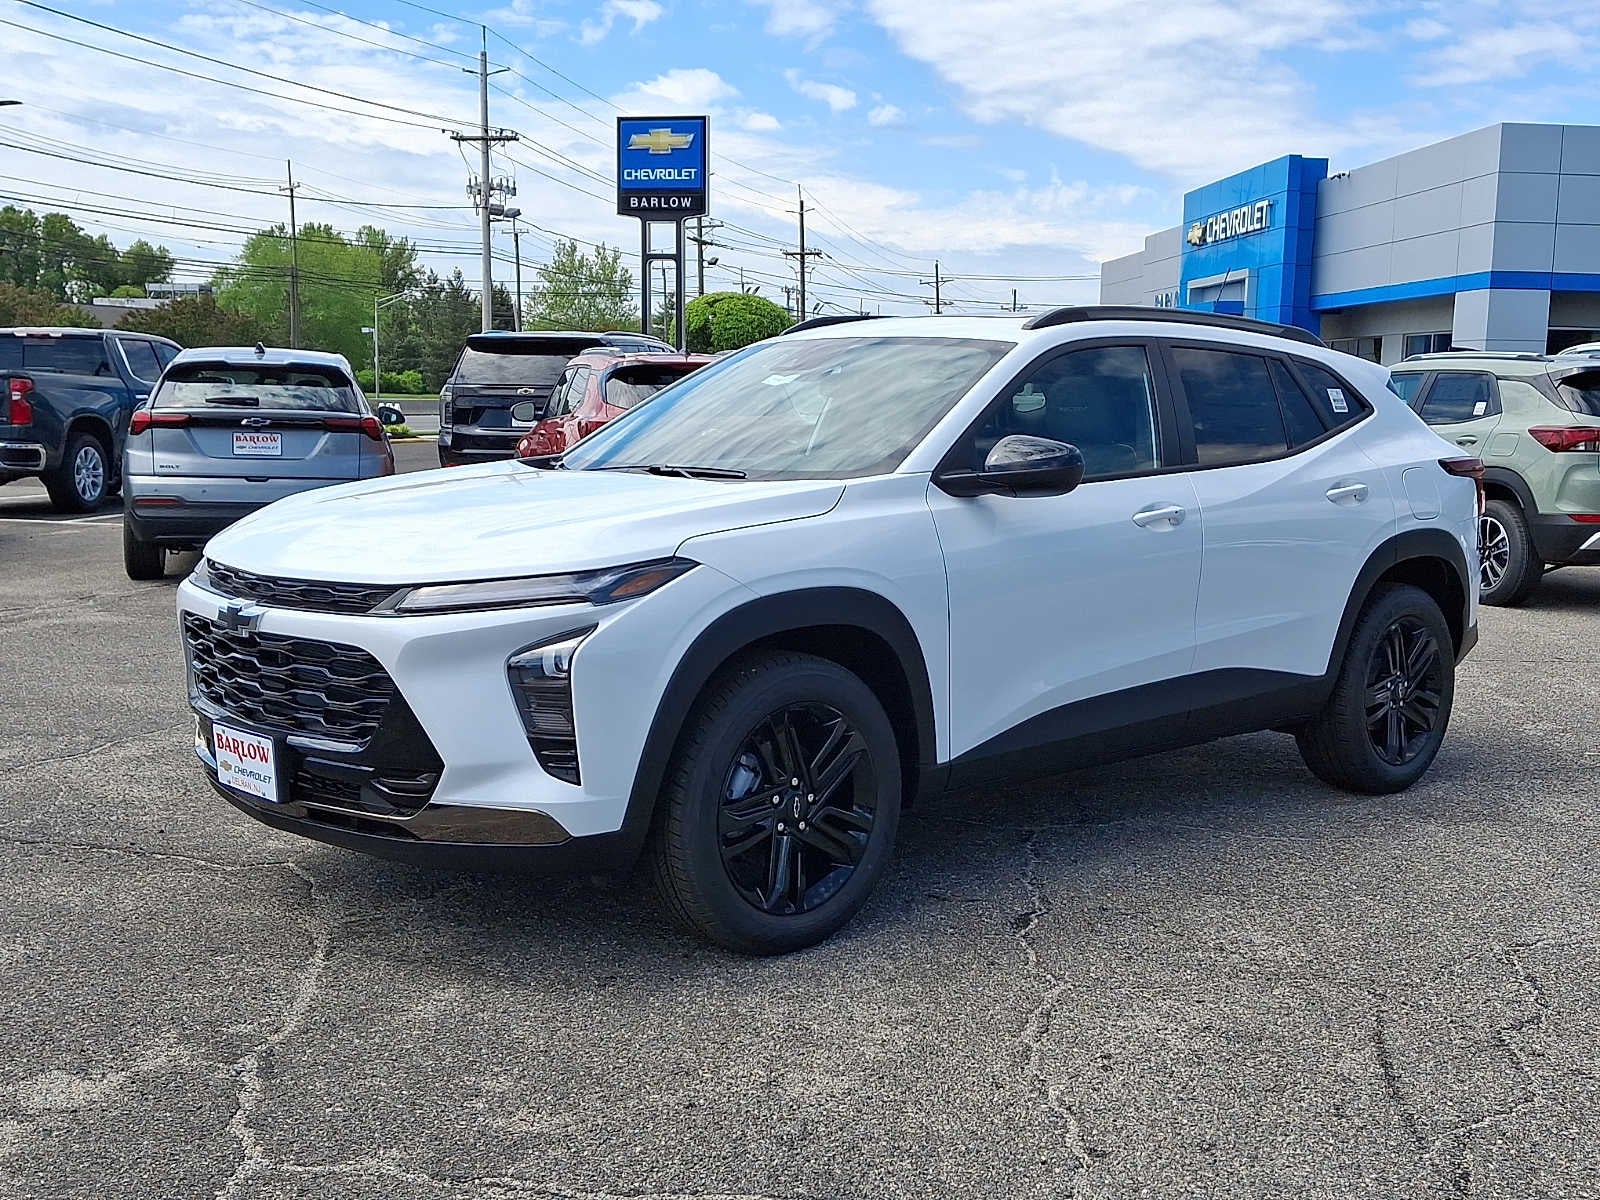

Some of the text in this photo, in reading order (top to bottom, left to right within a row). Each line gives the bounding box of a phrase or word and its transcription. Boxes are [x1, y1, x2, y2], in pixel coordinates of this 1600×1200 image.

[623, 168, 697, 180] CHEVROLET
[630, 197, 692, 208] BARLOW
[1206, 200, 1270, 243] CHEVROLET
[235, 435, 279, 445] BARLOW
[216, 732, 269, 764] BARLOW
[233, 765, 272, 784] CHEVROLET
